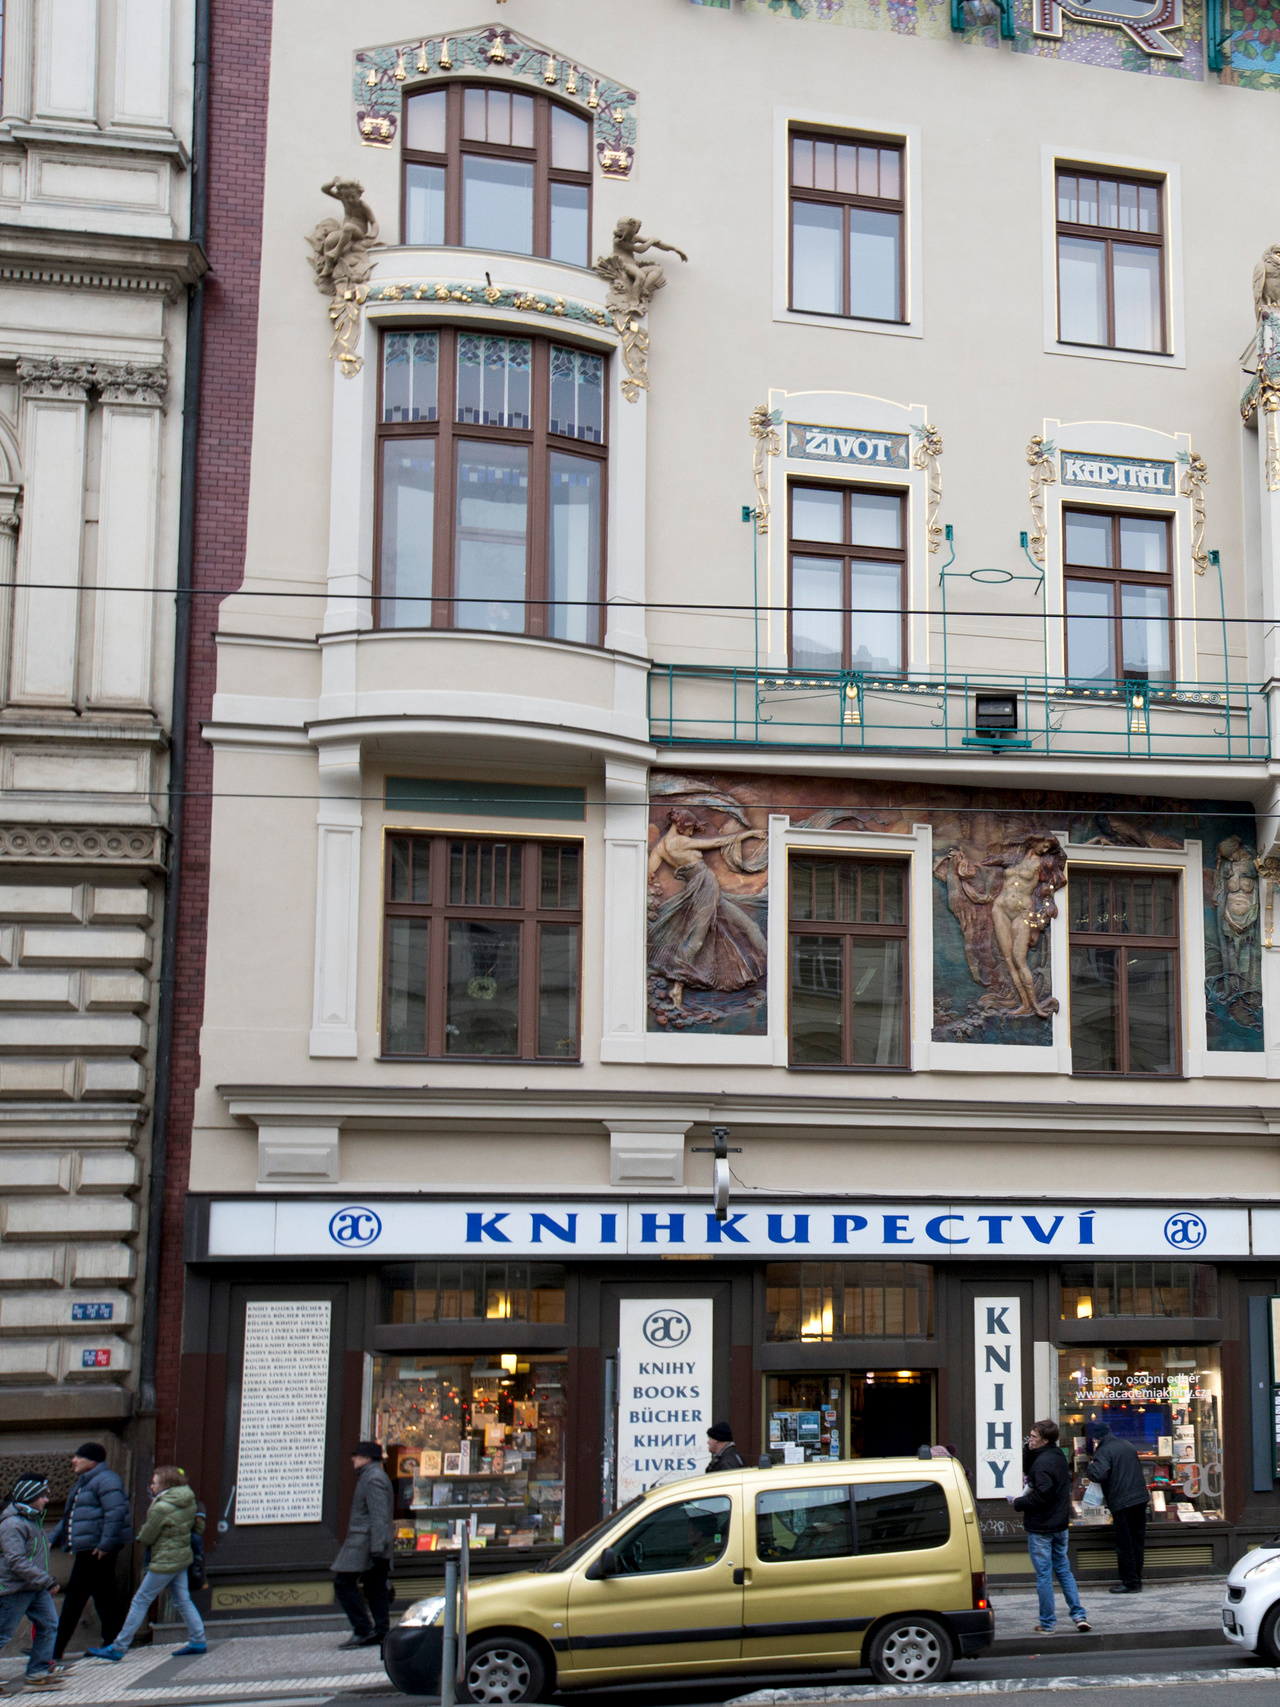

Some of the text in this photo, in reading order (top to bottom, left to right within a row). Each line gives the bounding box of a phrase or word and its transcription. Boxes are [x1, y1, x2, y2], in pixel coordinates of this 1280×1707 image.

[805, 429, 892, 461] ŽIVOT
[465, 1209, 1097, 1246] KNIHKUPECTVÍ
[638, 1362, 696, 1375] KNIHY
[1081, 1374, 1123, 1386] e-shop,
[1126, 1372, 1164, 1384] osobní
[633, 1385, 700, 1399] BOOKS
[984, 1306, 1012, 1489] KNIHY
[629, 1407, 703, 1424] BÜCHER
[634, 1434, 697, 1448] КНИГИ
[634, 1457, 697, 1472] LIVRES
